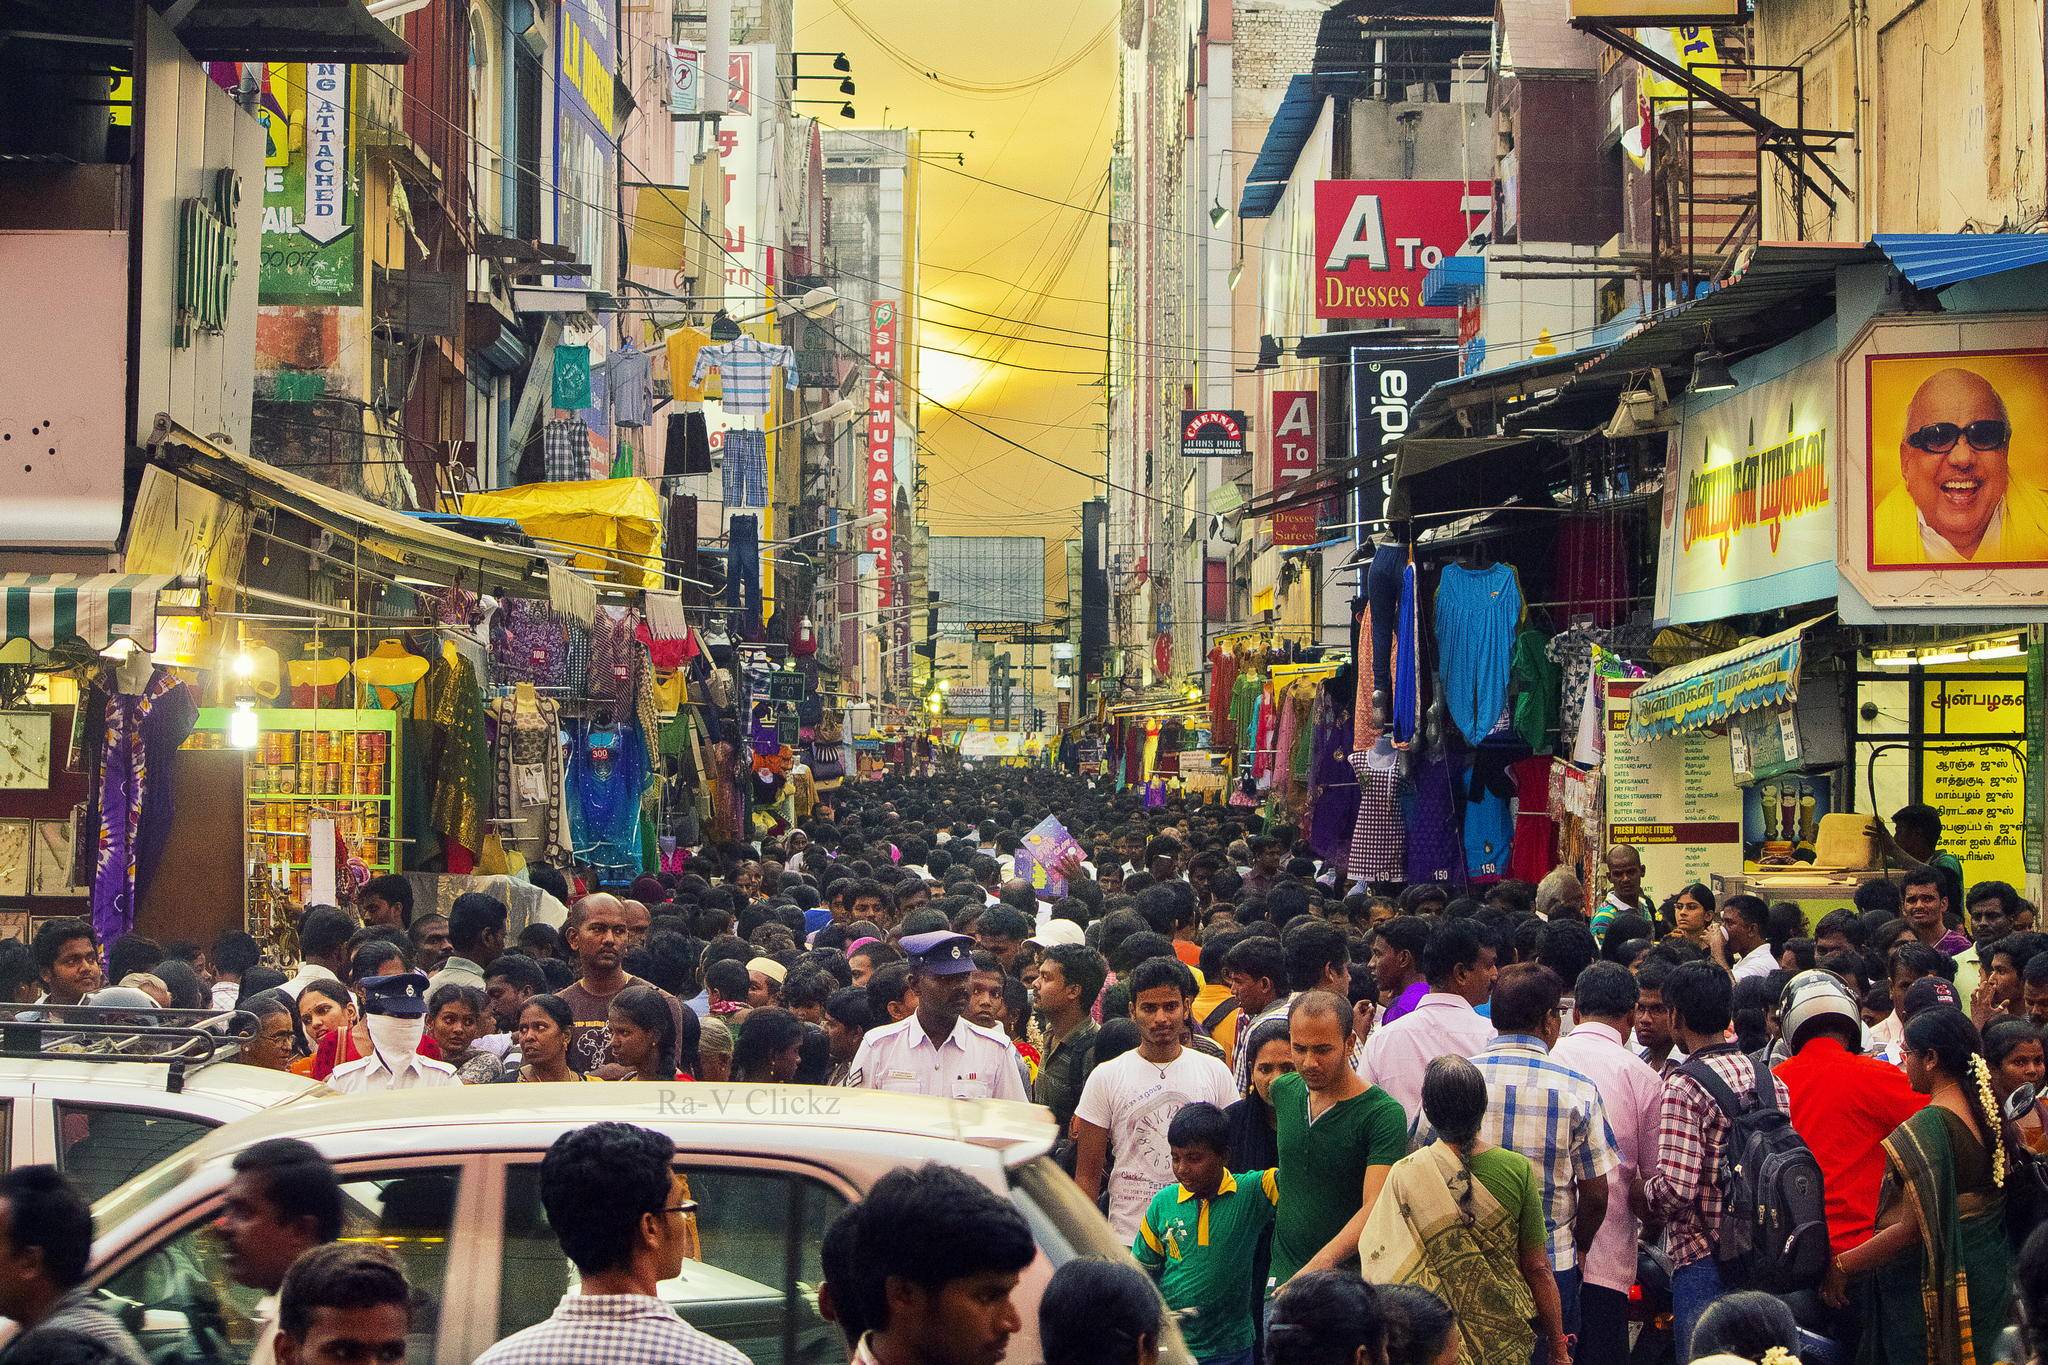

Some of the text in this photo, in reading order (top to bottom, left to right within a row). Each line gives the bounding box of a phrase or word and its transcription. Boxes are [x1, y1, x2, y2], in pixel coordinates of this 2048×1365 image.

[314, 101, 335, 217] ATTACHED
[1325, 195, 1389, 272] A
[1325, 277, 1409, 307] Dresses
[1187, 413, 1240, 437] CHENNAI
[1275, 513, 1315, 524] Dresses
[1275, 530, 1315, 541] Sarees
[592, 749, 608, 758] 300
[1936, 789, 1981, 802] மாம்பழம்
[1614, 825, 1674, 834] FRESH JUICE ITEMS
[1482, 863, 1495, 874] 150
[1376, 872, 1390, 882] 150
[1434, 870, 1448, 880] 150
[1144, 1084, 1162, 1098] GOLD
